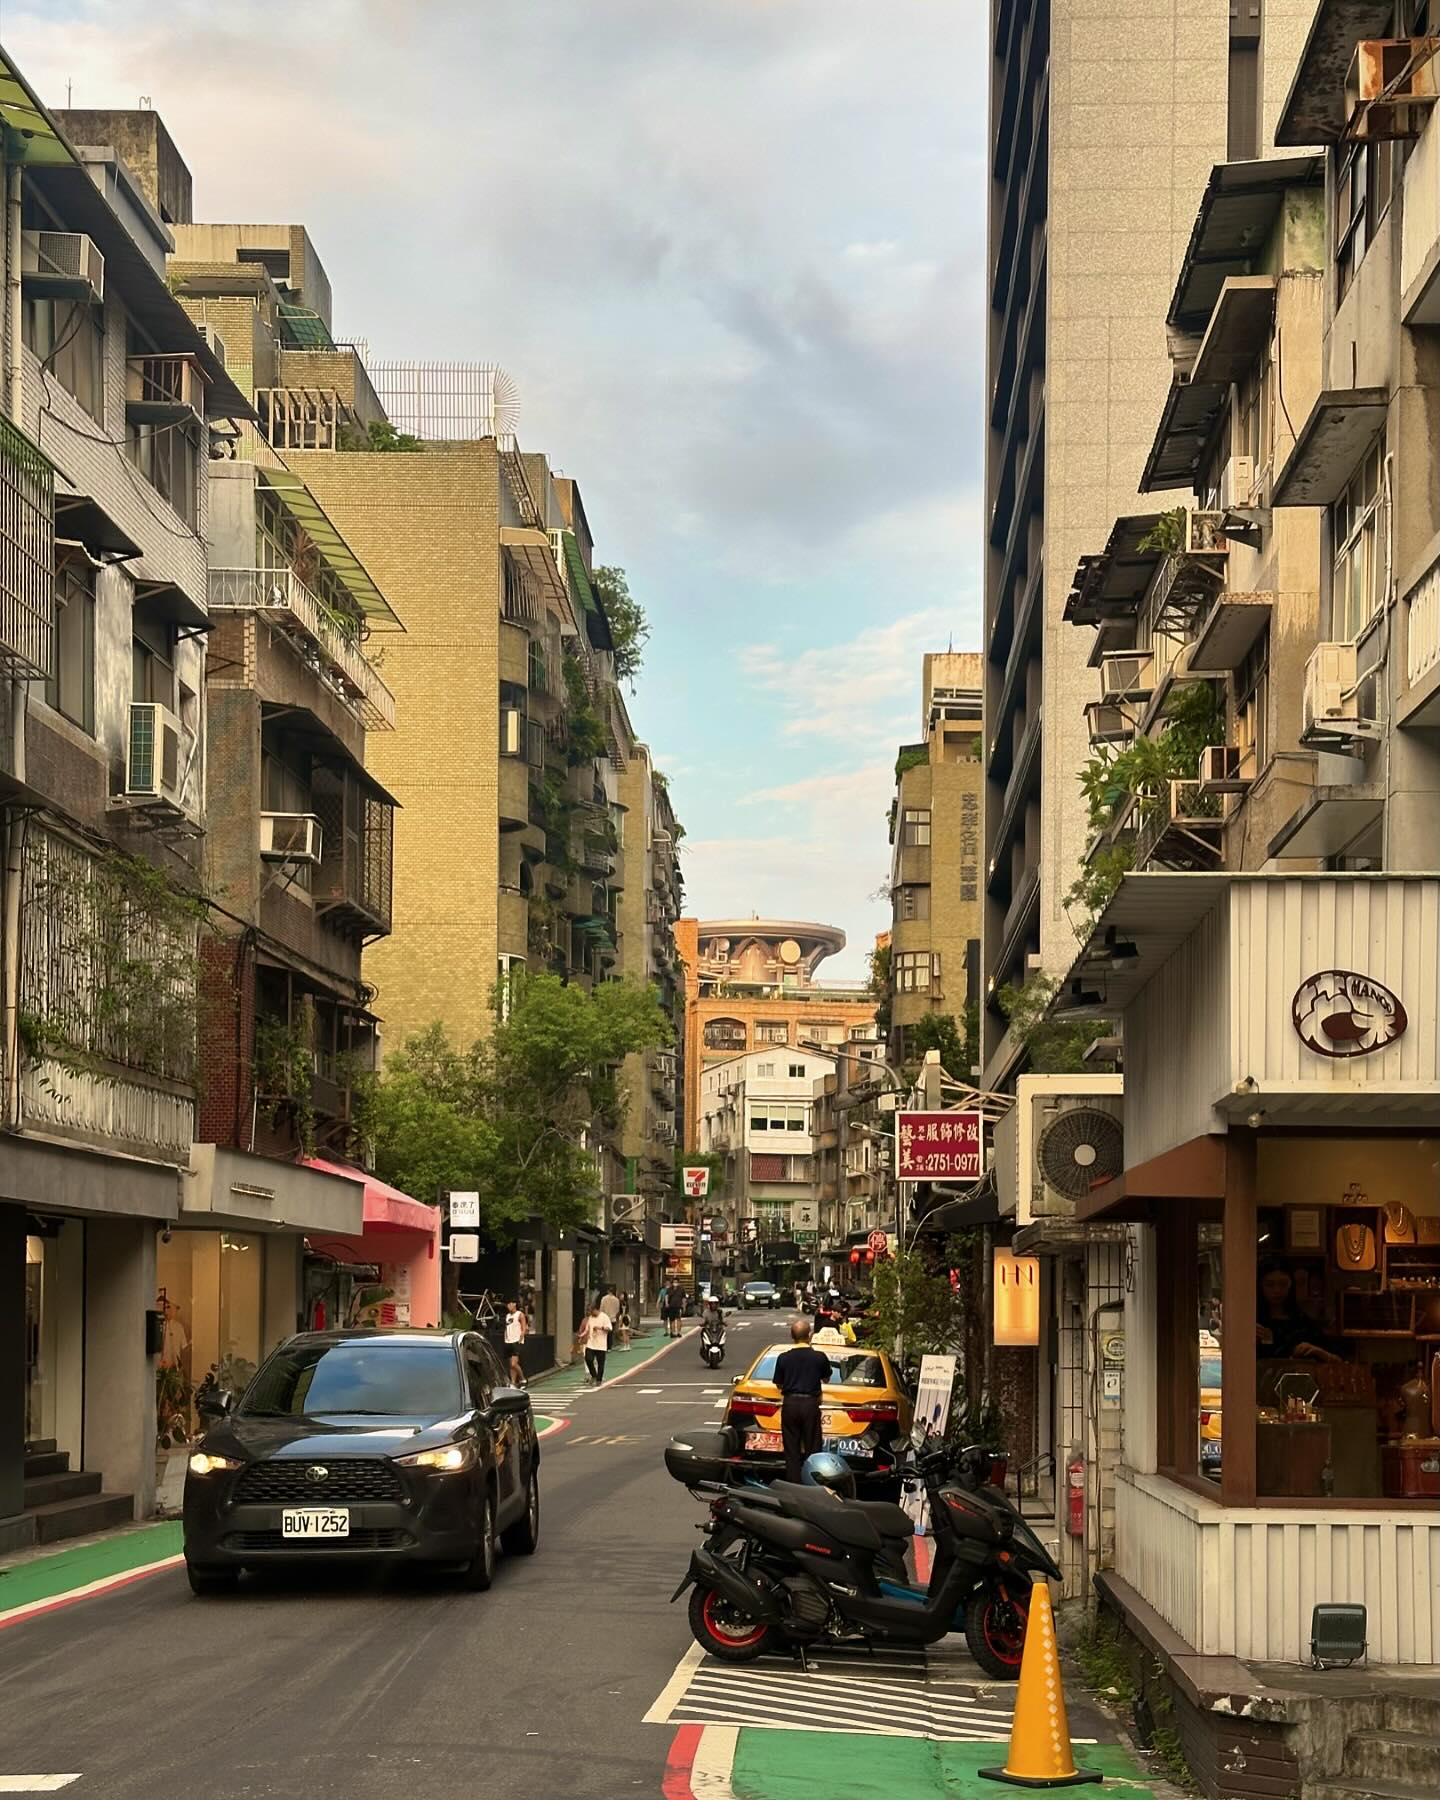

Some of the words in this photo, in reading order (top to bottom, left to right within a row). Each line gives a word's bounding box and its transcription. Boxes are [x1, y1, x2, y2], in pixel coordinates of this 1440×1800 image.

[926, 1121, 979, 1143] 服飾修改
[870, 1232, 886, 1250] 停
